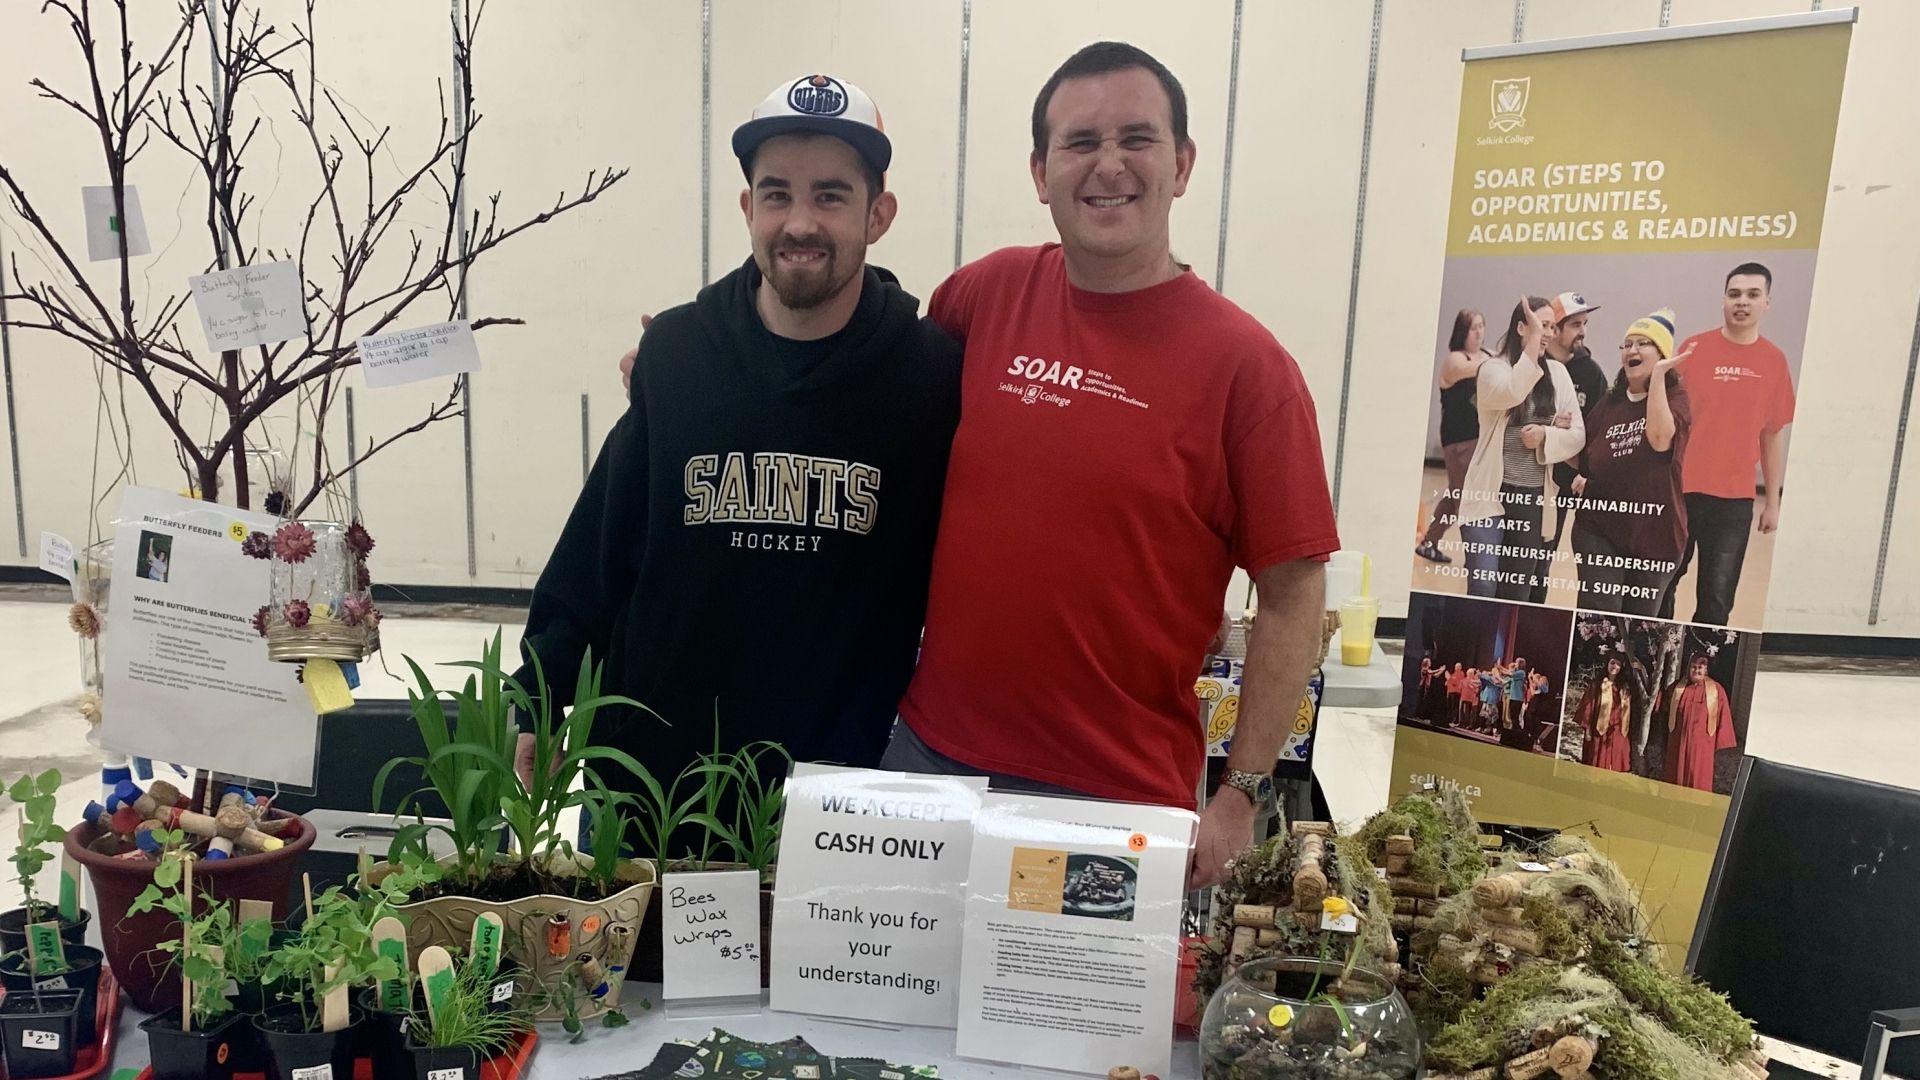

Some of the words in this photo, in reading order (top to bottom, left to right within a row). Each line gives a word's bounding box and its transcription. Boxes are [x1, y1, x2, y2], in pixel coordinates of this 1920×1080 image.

[794, 87, 842, 112] OILERS
[1476, 136, 1503, 146] Selkirk
[1504, 134, 1535, 145] College
[1473, 167, 1536, 190] SOAR
[1543, 162, 1623, 188] (STEPS
[1630, 160, 1665, 182] TO
[1470, 189, 1669, 217] OPPORTUNITIES,
[1467, 220, 1604, 244] ACADEMICS
[1611, 219, 1630, 240] &
[1638, 210, 1798, 240] READINESS)
[1007, 355, 1084, 390] SOAR
[1087, 369, 1104, 378] Steps
[1714, 366, 1741, 375] SOAR
[998, 382, 1024, 395] Selkirk
[1039, 391, 1071, 408] College
[1080, 385, 1112, 398] Academics
[1118, 393, 1149, 409] Readiness
[1605, 417, 1646, 439] SELKIR
[684, 452, 881, 535] SAINTS
[1442, 488, 1532, 506] AGRICULTURE
[1535, 494, 1545, 506] &
[1549, 495, 1665, 516] SUSTAINABILITY
[143, 515, 187, 531] BUTTERFLY
[187, 524, 223, 538] FEEDERS
[232, 525, 243, 537] $5
[1439, 513, 1494, 529] APPLIED
[1496, 518, 1531, 532] ARTS
[730, 531, 822, 552] HOCKEY
[1437, 539, 1570, 562] ENTREPRENEURSHIP
[1573, 552, 1583, 565] &
[1587, 553, 1676, 574] LEADERSHIP
[1434, 564, 1469, 579] FOOD
[1472, 568, 1526, 586] SERVICE
[1528, 575, 1539, 587] &
[1543, 576, 1589, 593] RETAIL
[1593, 582, 1660, 600] SUPPORT
[134, 595, 150, 603] WHY
[151, 599, 165, 607] ARE
[166, 602, 209, 616] BUTTERFLIES
[209, 611, 247, 624] BENEFICIAL
[822, 794, 856, 815] WE
[862, 799, 951, 822] ACCEPT
[814, 831, 875, 855] CASH
[881, 836, 945, 861] ONLY
[1133, 836, 1144, 848] $3
[669, 886, 716, 908] Bees
[686, 908, 728, 924] Wax
[807, 902, 864, 924] Thank
[869, 912, 904, 929] you
[910, 912, 938, 931] for
[674, 929, 732, 946] Wraps
[848, 941, 892, 958] your
[799, 965, 940, 995] understanding!
